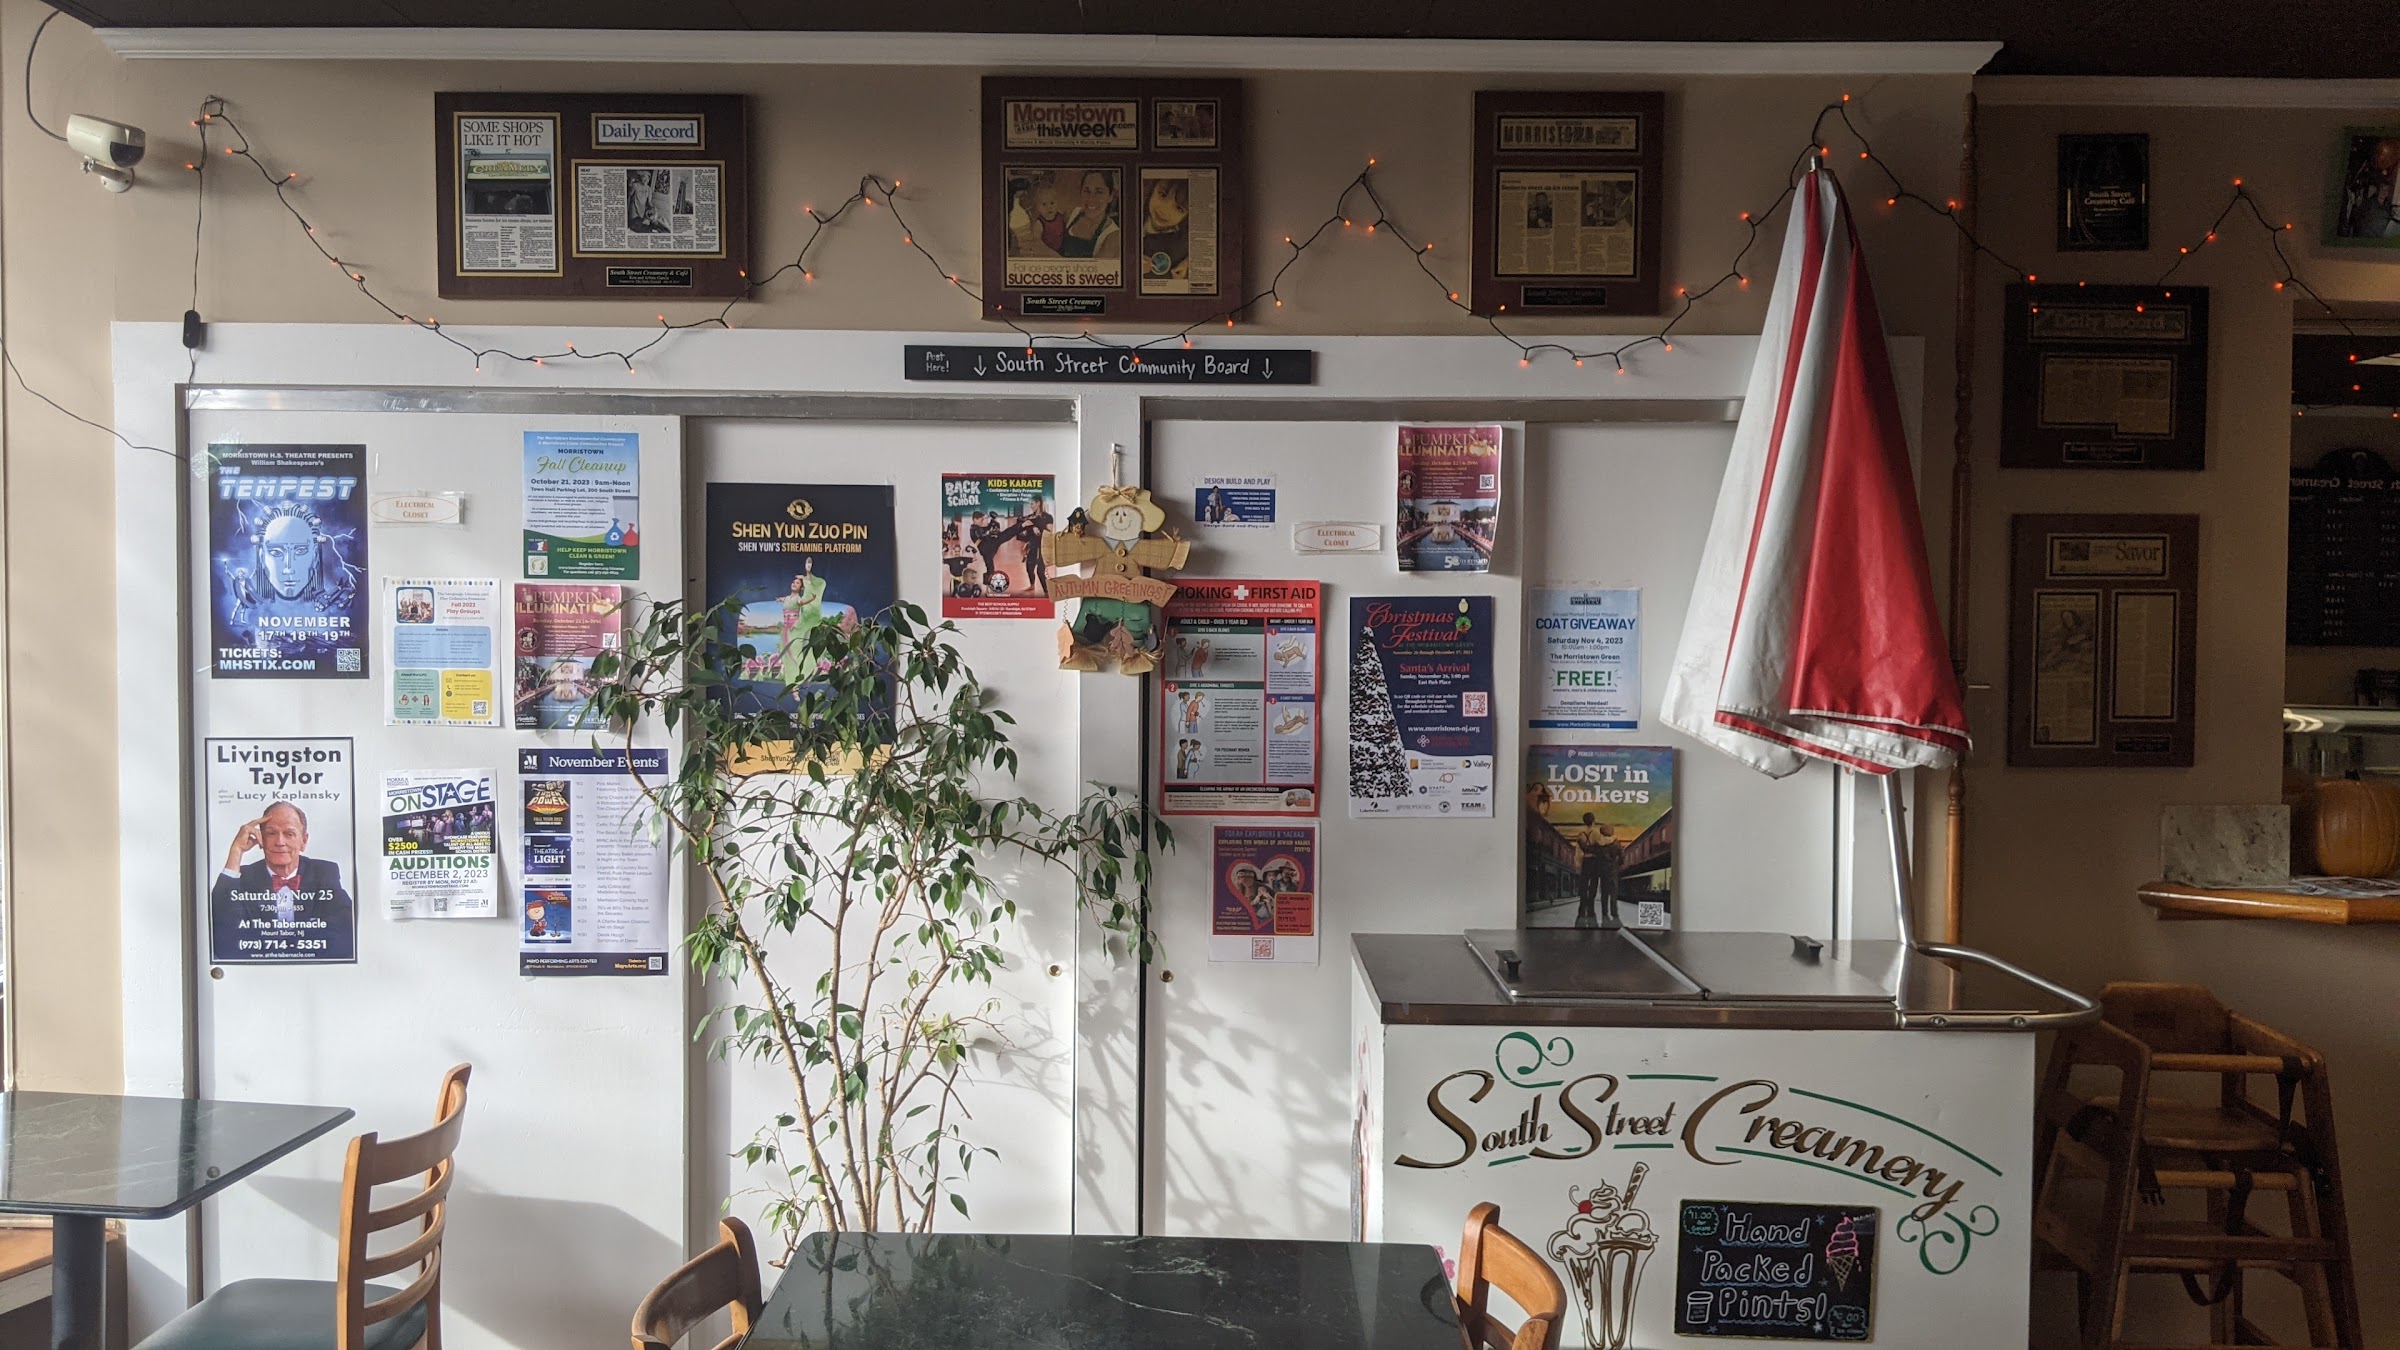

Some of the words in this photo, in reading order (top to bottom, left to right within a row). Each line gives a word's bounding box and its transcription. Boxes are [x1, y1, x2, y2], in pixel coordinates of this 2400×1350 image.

[1013, 104, 1125, 122] Morristown
[464, 122, 500, 133] SOME
[503, 122, 544, 133] SHOPS
[602, 124, 641, 141] Daily
[644, 124, 694, 138] Record
[464, 135, 494, 146] LIKE
[497, 135, 509, 146] IT
[511, 135, 541, 146] HOT
[1009, 272, 1062, 285] success
[1066, 270, 1076, 285] is
[1079, 270, 1119, 285] sweet
[1069, 298, 1102, 306] Creamery
[926, 352, 945, 362] Post
[926, 362, 949, 372] Here!
[996, 352, 1044, 373] South
[1055, 357, 1108, 374] Street
[1119, 357, 1195, 380] Community
[1205, 355, 1248, 375] Board
[1412, 434, 1479, 445] PUMPKIN
[537, 456, 565, 474] Fall
[569, 456, 626, 475] Cleanup
[220, 478, 356, 498] TEMPEST
[945, 480, 981, 495] BACK
[988, 479, 1007, 487] KIDS
[396, 501, 434, 509] ELECTRICAL
[947, 496, 980, 506] SCHOOL
[732, 522, 771, 538] SHEN
[774, 522, 802, 538] YUN
[809, 523, 840, 539] ZUO
[842, 523, 868, 540] PIN
[738, 542, 757, 551] SHEN
[759, 542, 780, 552] YUN'S
[782, 543, 822, 552] STREAMING
[824, 543, 862, 553] PLATFORM
[1055, 581, 1099, 597] AUTUMN
[1176, 587, 1232, 599] HOKING
[1252, 588, 1288, 599] FIRST
[1291, 588, 1316, 599] AID
[534, 592, 601, 602] PUMPKIN
[1366, 603, 1453, 627] Christmas
[259, 616, 350, 627] NOVEMBER
[1536, 618, 1568, 629] COAT
[1570, 619, 1635, 629] GIVEAWAY
[259, 631, 285, 641] 17TH
[292, 631, 318, 641] 18TH
[323, 631, 350, 641] 19TH
[1382, 622, 1460, 649] Festival
[1547, 637, 1579, 645] Saturday
[220, 648, 282, 658] TICKETS:
[220, 660, 316, 670] MHSTIX.COM
[1400, 664, 1433, 672] Santa's
[1437, 664, 1470, 672] Arrival
[1557, 671, 1612, 686] FREE!
[1408, 725, 1480, 733] www.morristown-nj.org
[218, 745, 341, 767] Livingston
[549, 756, 614, 768] November
[1473, 761, 1491, 769] Valley
[249, 767, 323, 789] Taylor
[1548, 765, 1618, 783] LOST
[1624, 766, 1649, 783] in
[237, 791, 266, 801] Lucy
[272, 791, 340, 801] Kaplansky
[1547, 785, 1649, 804] Yonkers
[390, 794, 421, 812] ON
[389, 856, 489, 870] AUDITIONS
[534, 855, 566, 864] LIGHT
[391, 871, 450, 880] DECEMBER
[453, 870, 461, 879] 2,
[465, 870, 488, 879] 2023
[231, 890, 288, 902] Saturday,
[291, 890, 315, 900] Nov
[319, 890, 333, 900] 25
[239, 920, 250, 928] At
[253, 919, 271, 928] The
[272, 919, 327, 928] Tabernacle
[239, 939, 262, 950] (973)
[265, 940, 287, 949] 714
[298, 940, 327, 949] 5351
[1394, 1069, 1553, 1170] South
[1529, 1073, 1676, 1160] Street
[1680, 1079, 1967, 1222] Creamery
[1726, 1212, 1810, 1244] Hand
[1702, 1250, 1813, 1284] Packed
[1719, 1287, 1827, 1321] Pints!
